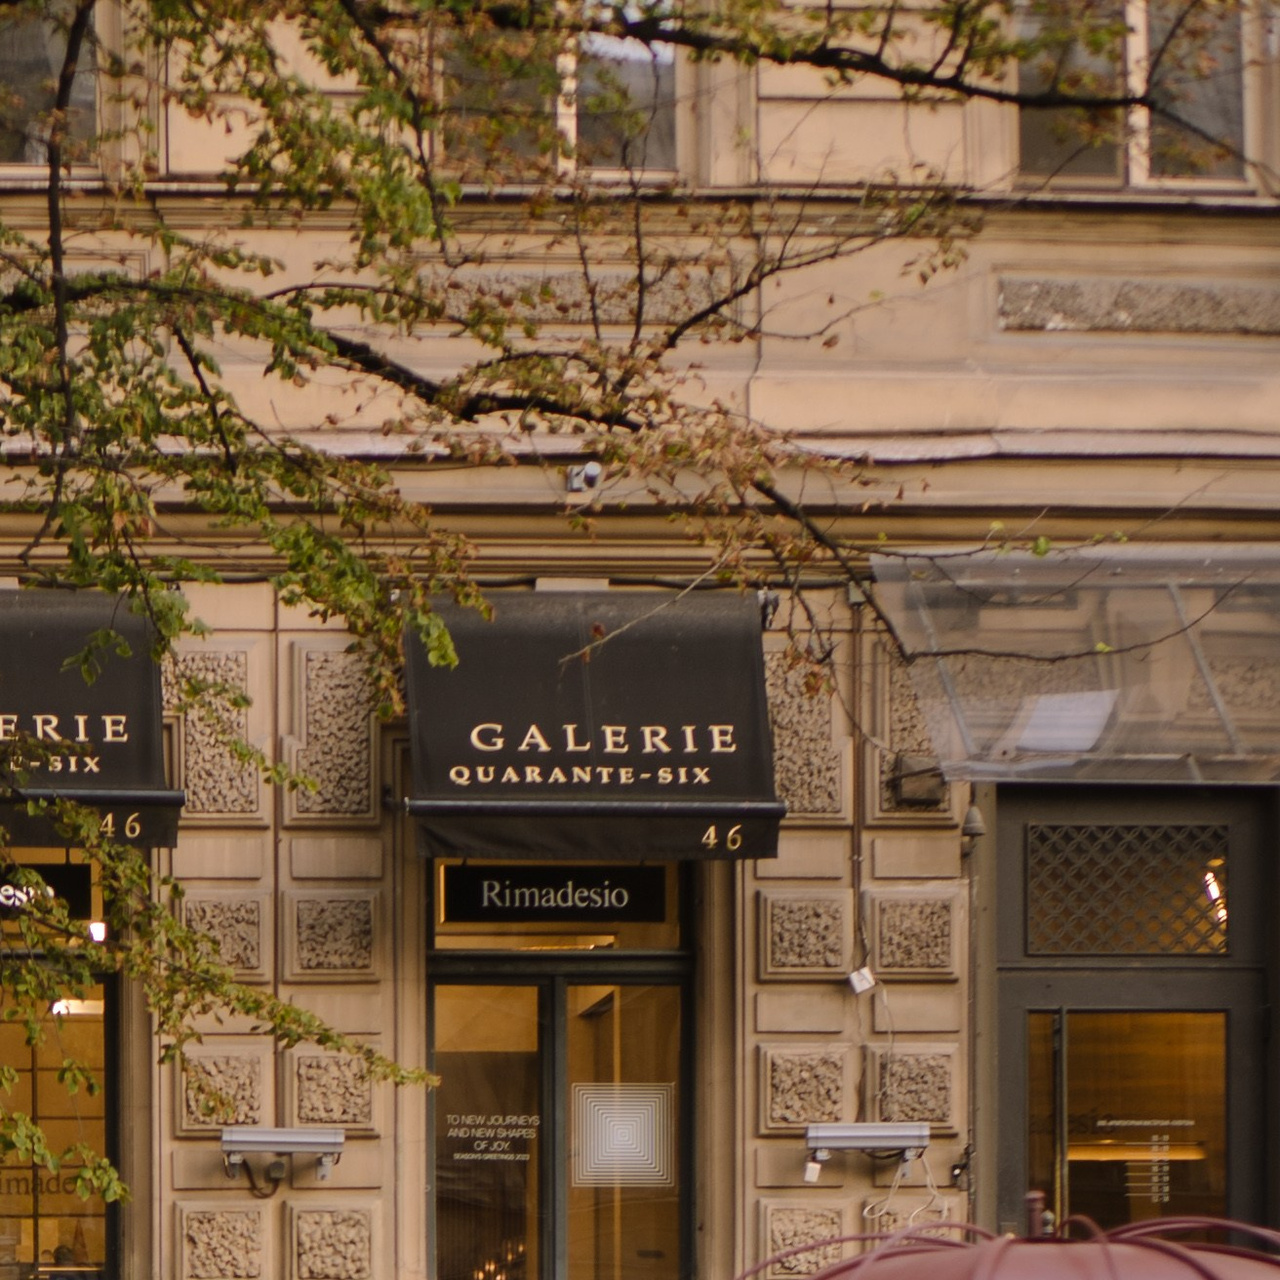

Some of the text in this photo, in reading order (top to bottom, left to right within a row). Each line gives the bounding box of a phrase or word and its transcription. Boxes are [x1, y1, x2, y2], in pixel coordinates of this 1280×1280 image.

[470, 723, 737, 754] GALERIE
[449, 766, 711, 786] QUARANTE-SIX
[99, 812, 141, 838] 46
[701, 824, 743, 851] 46
[481, 880, 629, 908] Rimadesio
[446, 1114, 540, 1126] TO NEW JOURNEYS
[448, 1127, 470, 1138] AND
[471, 1127, 496, 1139] NEW
[474, 1140, 488, 1151] OF
